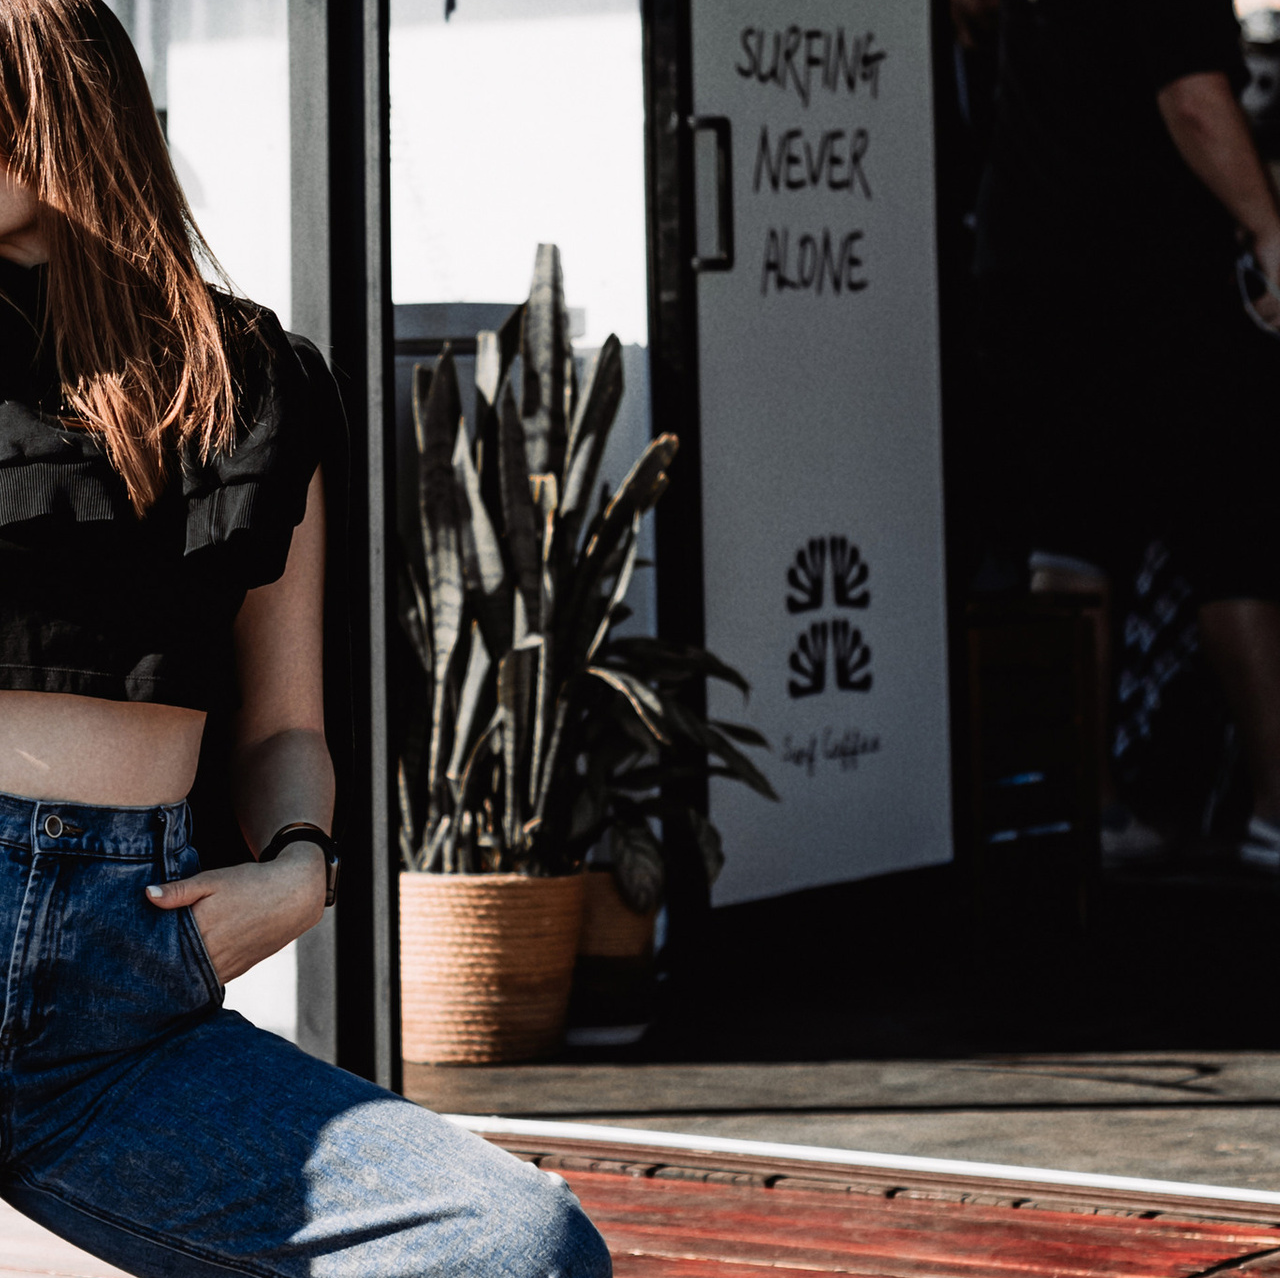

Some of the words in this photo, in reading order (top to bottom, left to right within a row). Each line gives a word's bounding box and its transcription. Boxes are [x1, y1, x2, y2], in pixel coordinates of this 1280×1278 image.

[735, 25, 887, 109] SURFING
[753, 124, 872, 201] NEVER
[760, 227, 869, 297] ALONE
